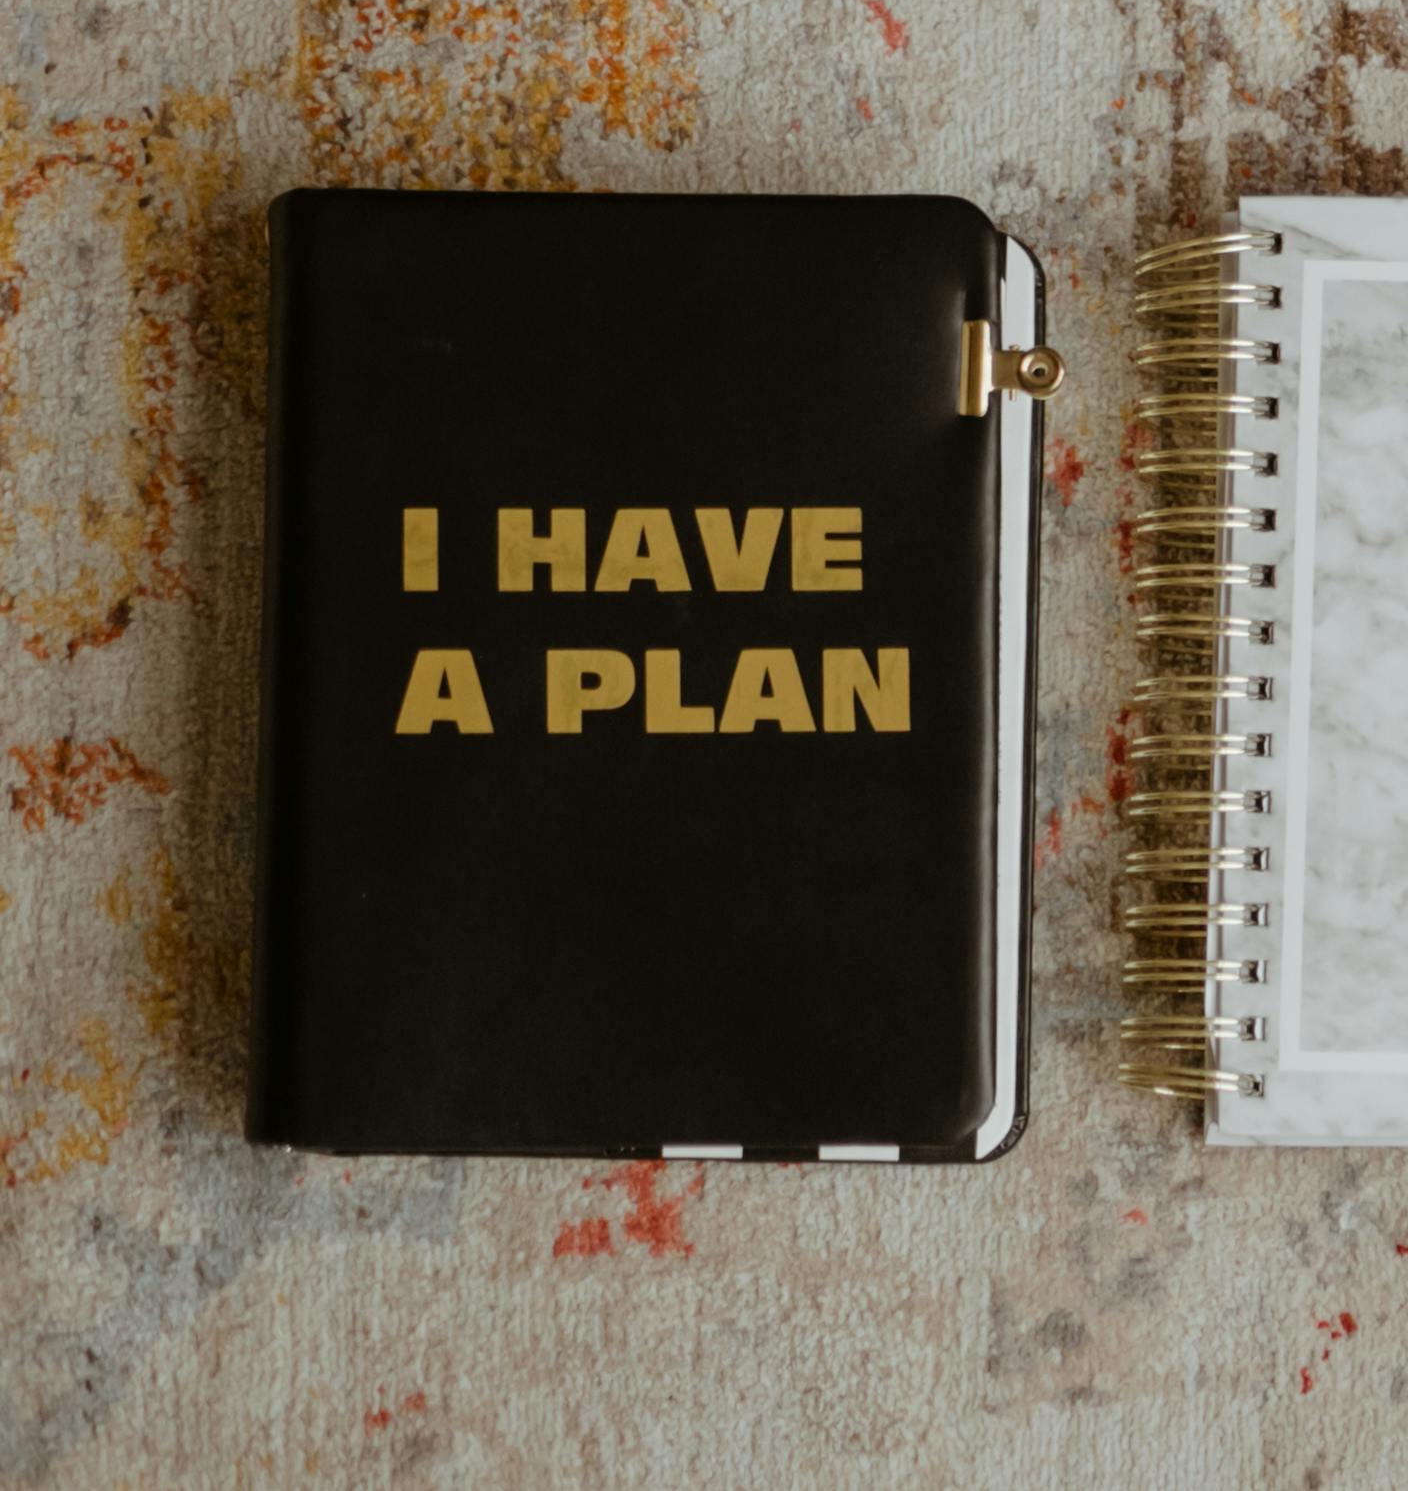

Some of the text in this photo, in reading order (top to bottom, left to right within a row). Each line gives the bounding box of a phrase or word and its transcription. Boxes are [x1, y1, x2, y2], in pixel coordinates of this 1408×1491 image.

[402, 506, 864, 593] I HAVE
[395, 647, 912, 735] A PLAN
